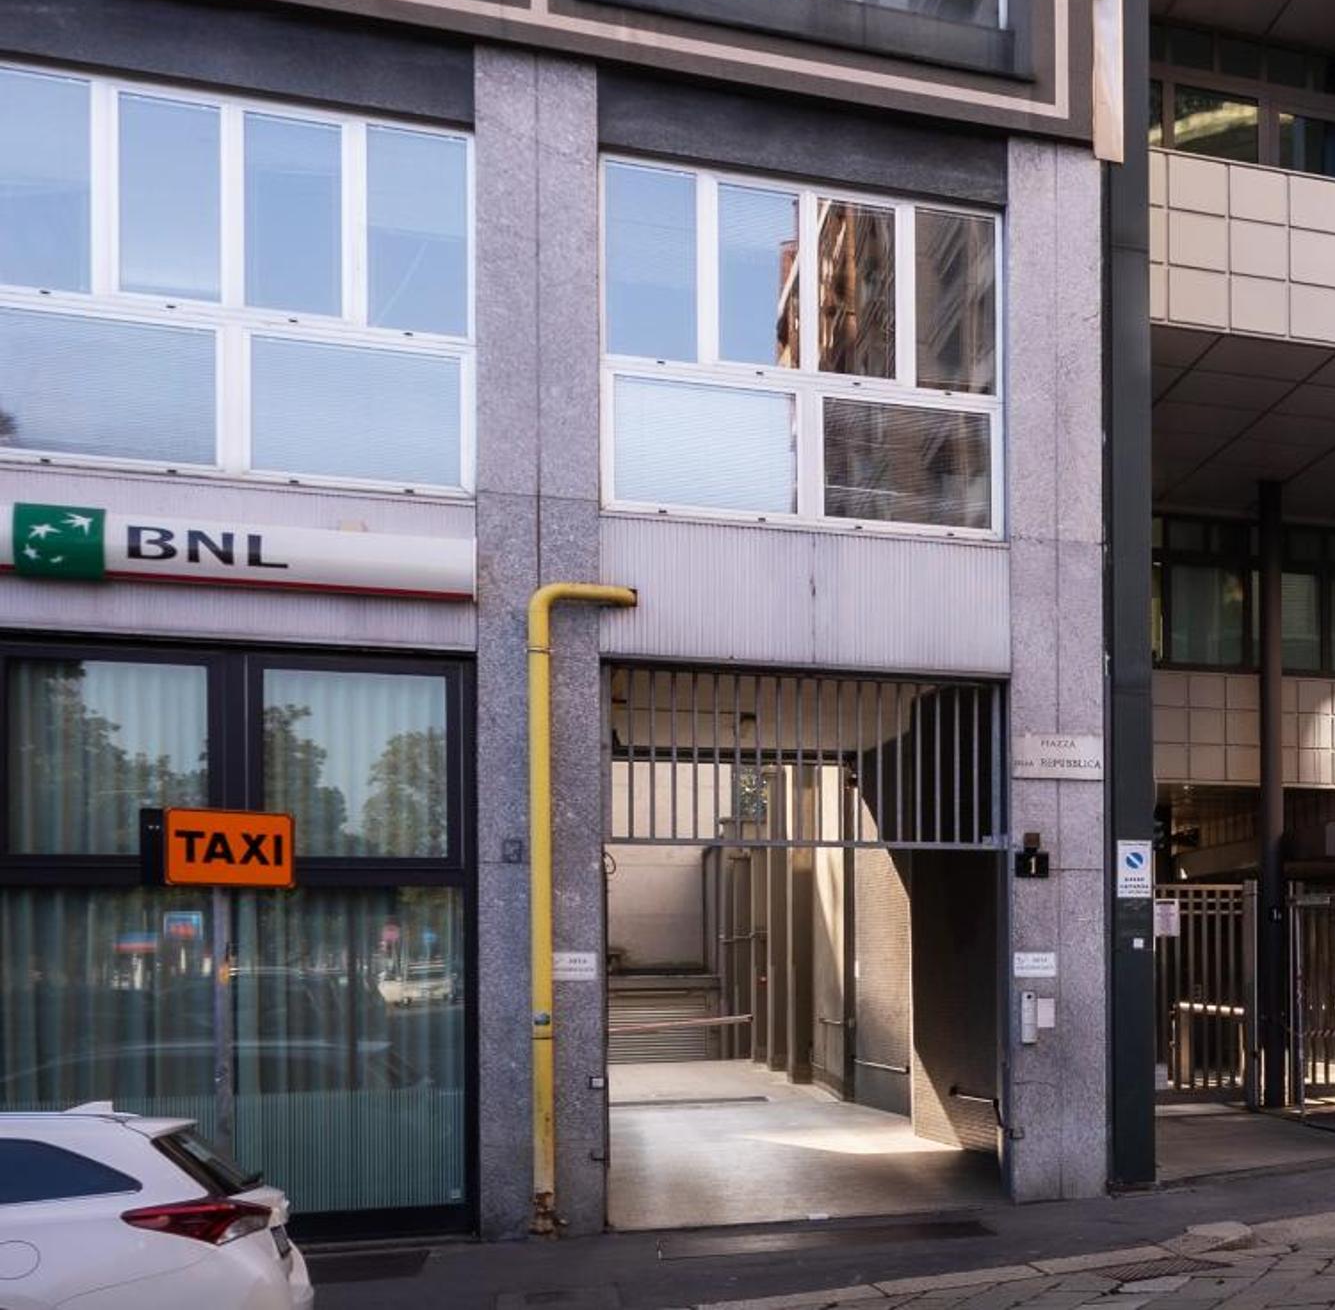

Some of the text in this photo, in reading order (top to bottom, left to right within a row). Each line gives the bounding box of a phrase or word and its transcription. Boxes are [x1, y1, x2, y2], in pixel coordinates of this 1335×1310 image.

[127, 525, 289, 569] BNL
[1041, 739, 1077, 748] PIAZZA
[1041, 757, 1102, 769] REPUBBLICA
[174, 829, 284, 867] TAXI
[1029, 855, 1037, 875] 1
